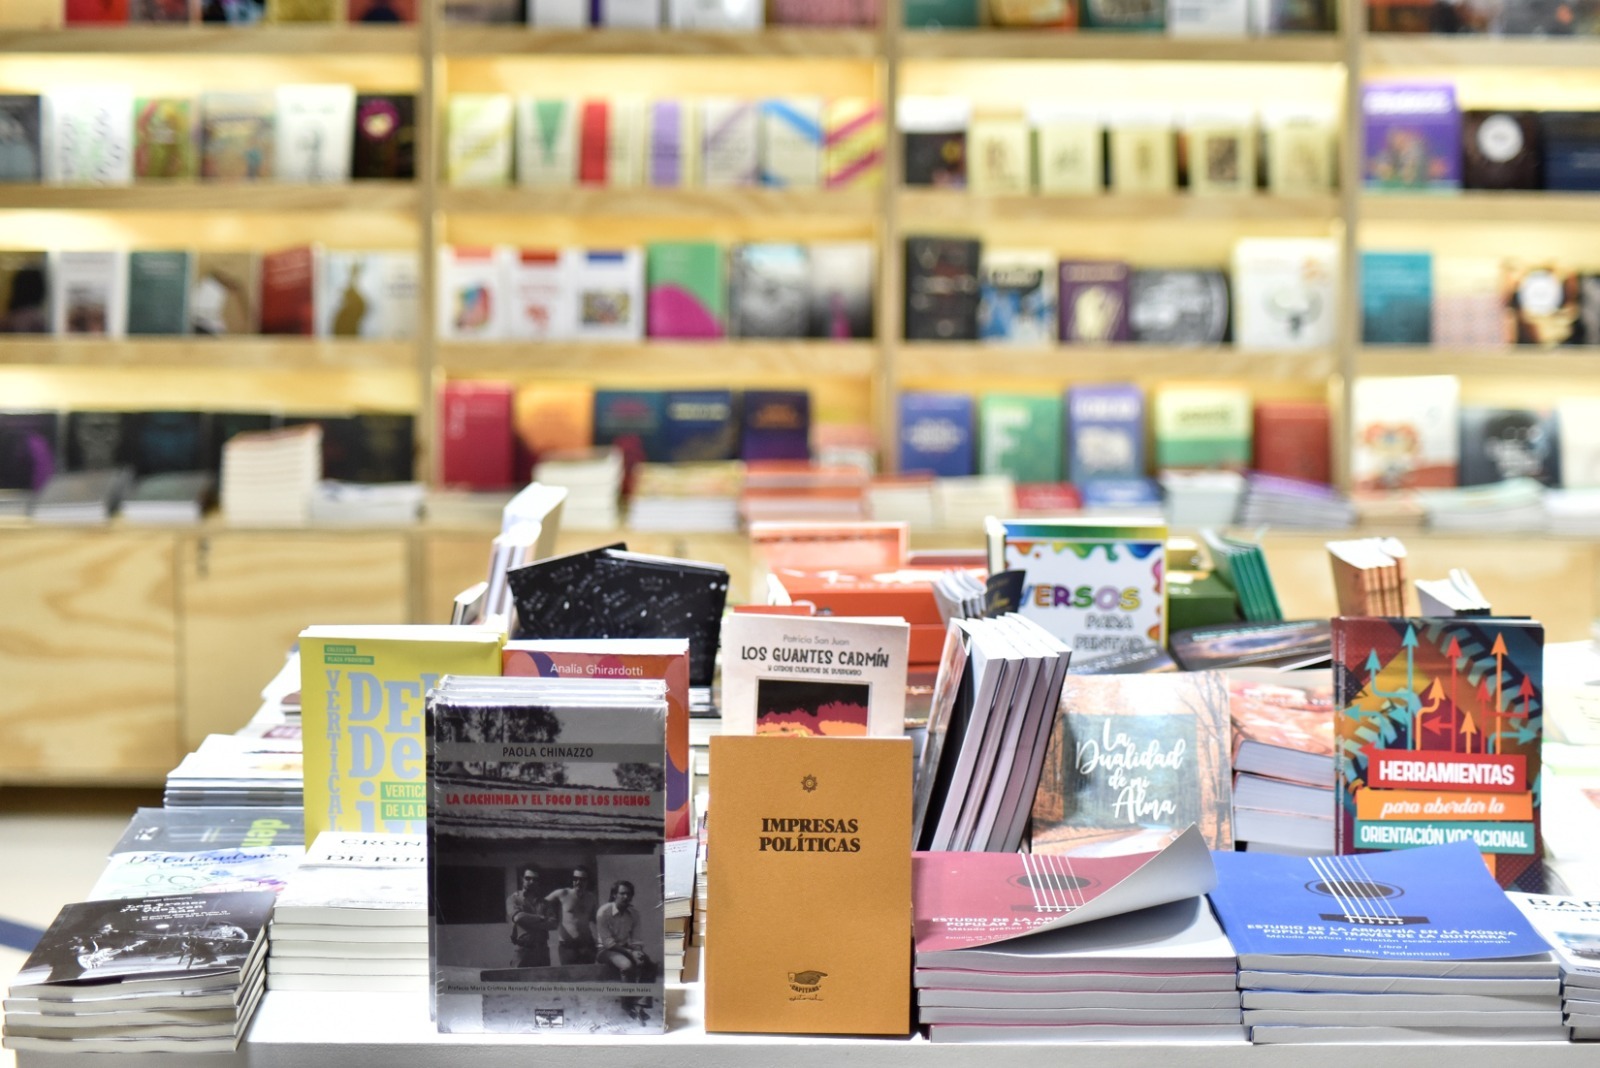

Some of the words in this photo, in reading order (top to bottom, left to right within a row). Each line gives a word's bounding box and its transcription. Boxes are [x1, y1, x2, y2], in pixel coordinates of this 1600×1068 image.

[1085, 613, 1134, 629] PARA
[814, 635, 829, 644] San
[831, 636, 850, 646] Juan
[741, 645, 767, 661] LOS
[772, 647, 833, 665] GUANTES
[838, 646, 889, 668] CARMÍN
[550, 663, 582, 675] Analía
[586, 664, 643, 676] Ghirardotti
[1103, 718, 1131, 751] La
[502, 746, 537, 758] PAOLA
[540, 747, 594, 758] CHINAZZO
[1075, 738, 1186, 775] Dualidad
[1108, 767, 1127, 790] de
[1379, 760, 1515, 785] HERRAMIENTAS
[386, 804, 397, 816] DE
[402, 804, 414, 817] LA
[445, 793, 460, 806] LA
[463, 793, 519, 806] CACHIMBA
[521, 794, 529, 806] Y
[531, 794, 542, 806] EL
[545, 794, 571, 807] FOCO
[573, 794, 588, 807] DE
[590, 794, 610, 807] LOS
[612, 795, 651, 807] SIGNOS
[1112, 786, 1176, 824] Alma
[1380, 801, 1421, 819] para
[1423, 797, 1486, 814] abordar
[1487, 797, 1505, 814] la
[761, 818, 859, 833] IMPRESAS
[759, 833, 861, 853] POLÍTICAS
[1360, 825, 1444, 845] ORIENTACIÓN
[1445, 828, 1528, 848] VOCACIONAL
